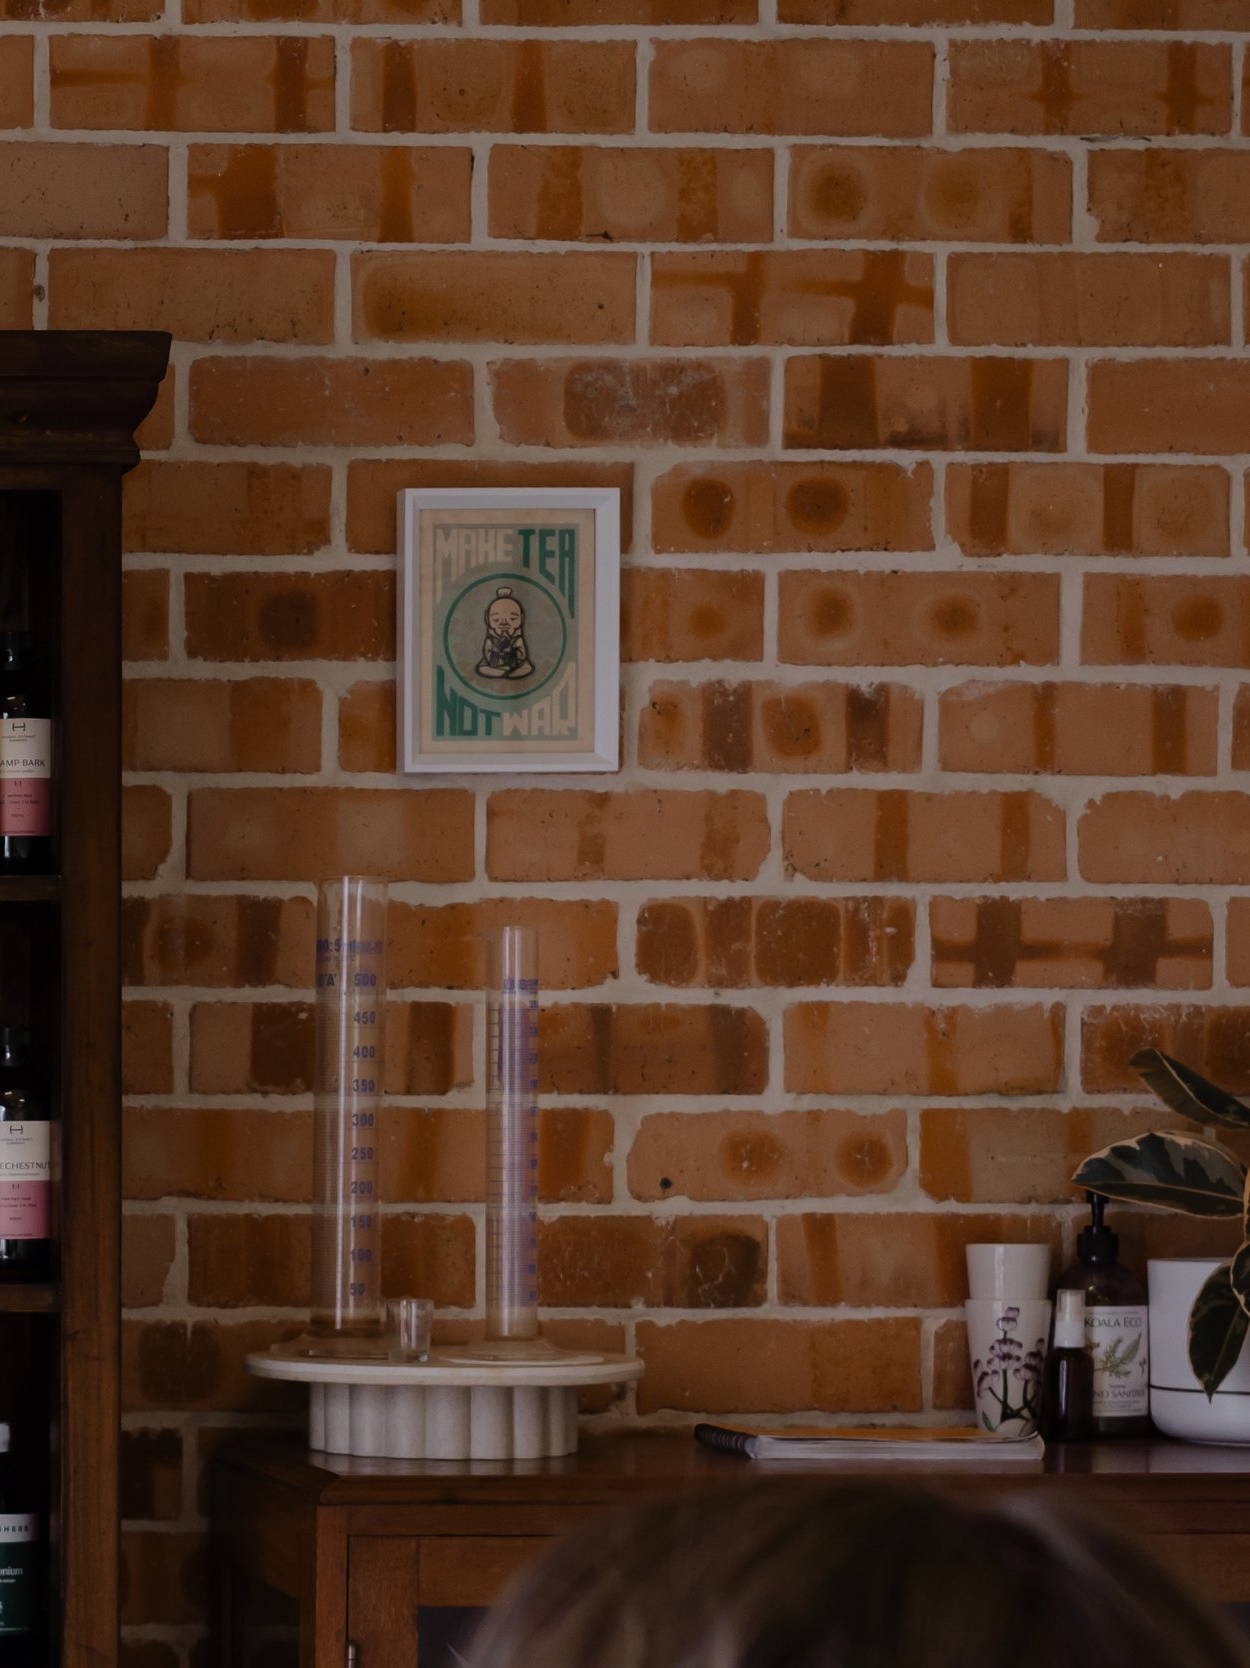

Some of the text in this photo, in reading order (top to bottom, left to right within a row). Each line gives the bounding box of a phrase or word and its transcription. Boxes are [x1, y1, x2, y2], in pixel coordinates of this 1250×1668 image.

[435, 528, 575, 619] MAKE TEA
[436, 661, 576, 736] NOT WAR
[22, 759, 46, 767] BARK
[354, 973, 376, 987] 500
[354, 1011, 376, 1024] 450
[353, 1046, 376, 1059] 400
[352, 1079, 375, 1093] 350
[352, 1113, 374, 1127] 300
[351, 1147, 374, 1161] 250
[350, 1181, 373, 1194] 200
[350, 1215, 372, 1229] 150
[350, 1248, 372, 1263] 100
[1085, 1317, 1121, 1328] KOALA
